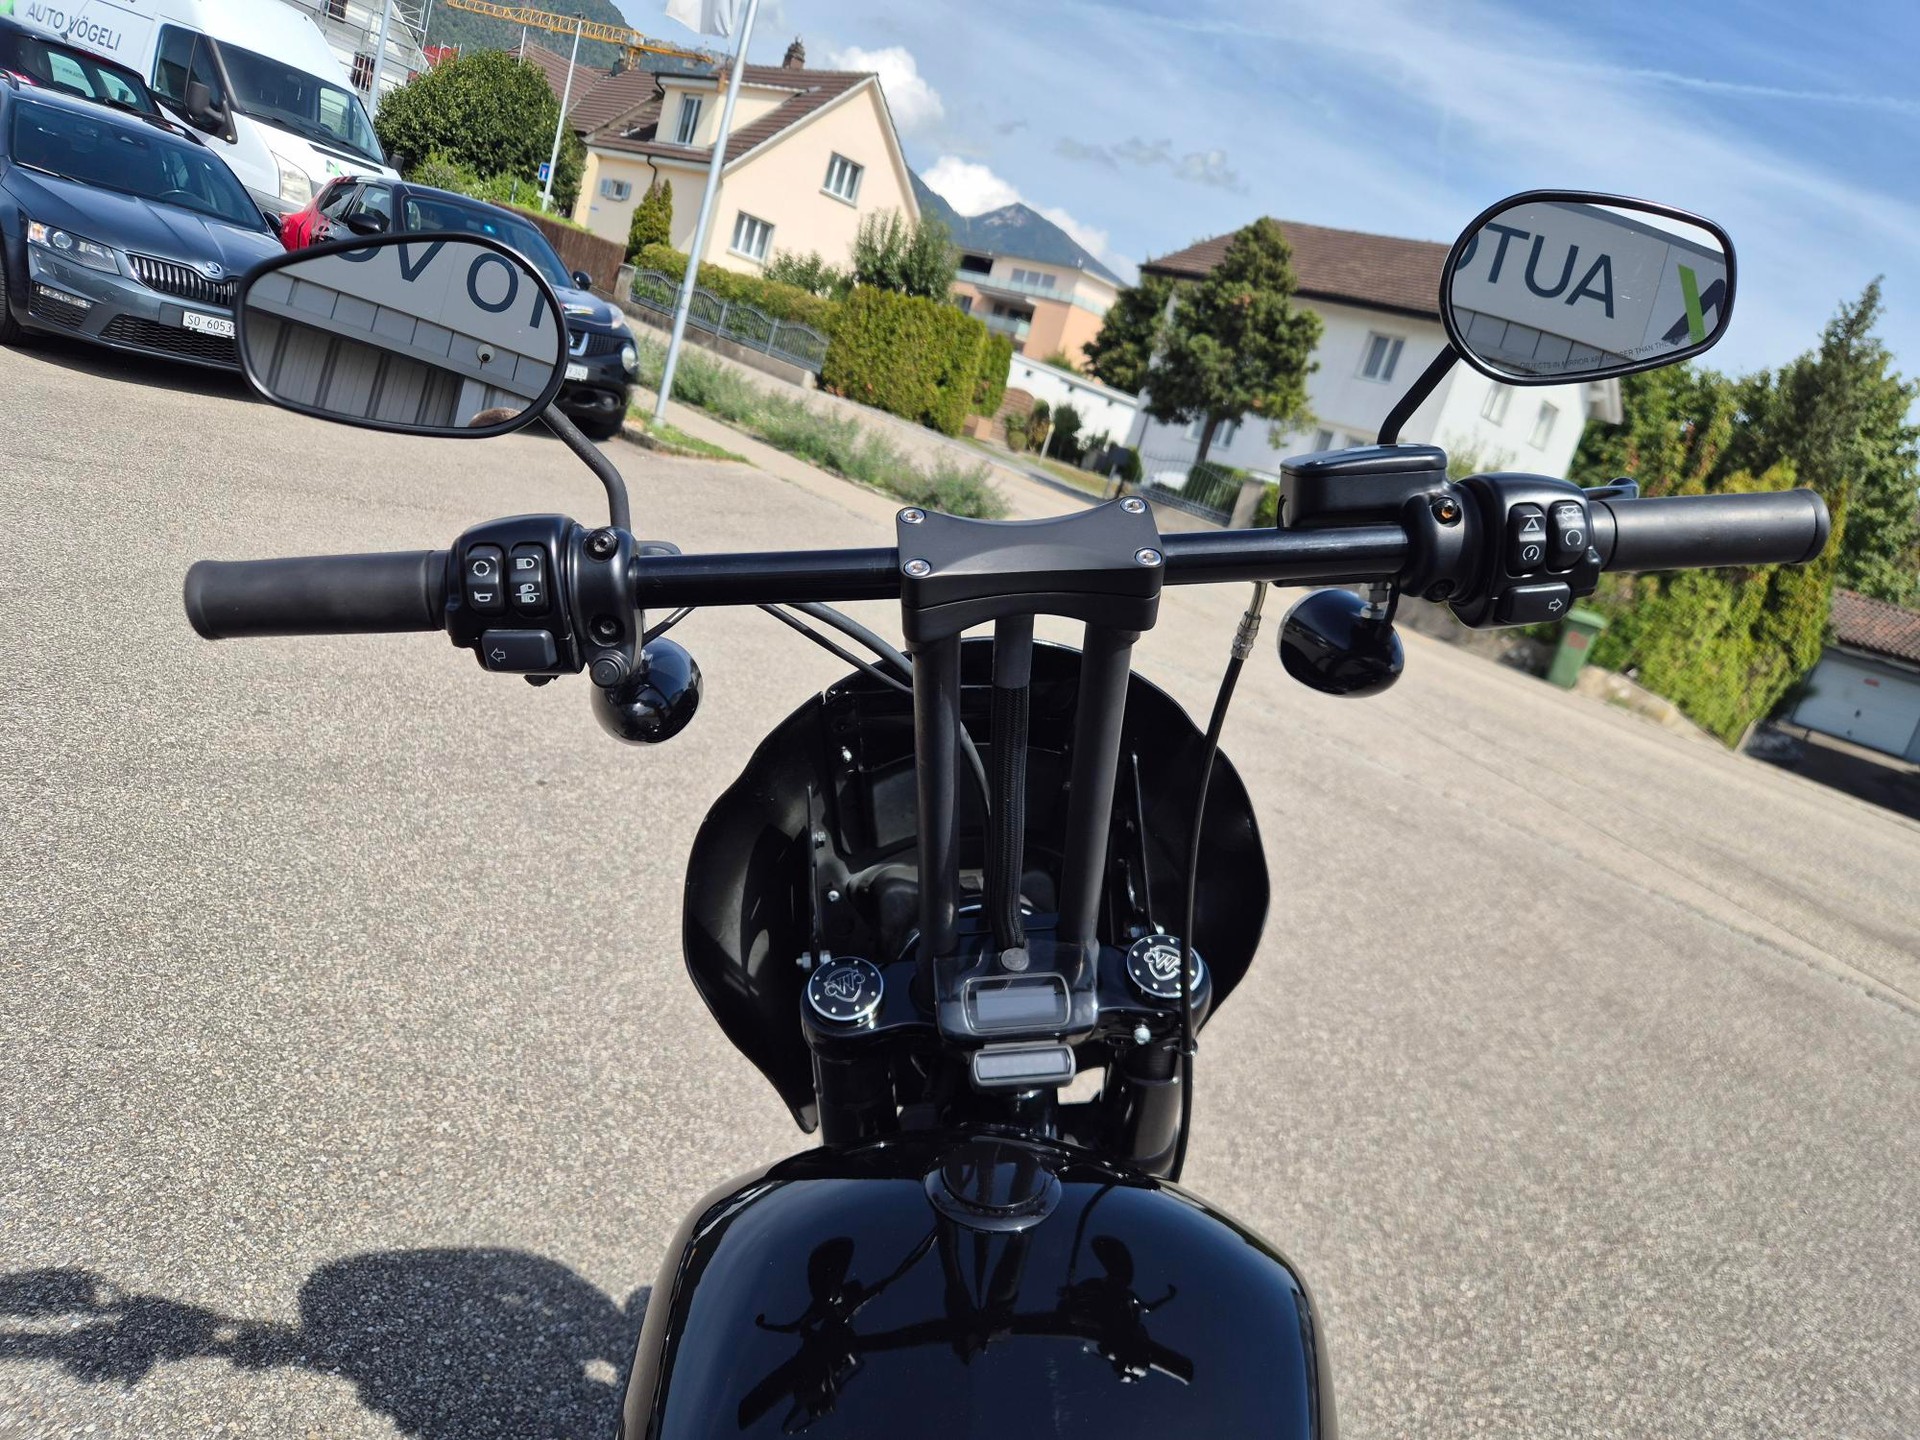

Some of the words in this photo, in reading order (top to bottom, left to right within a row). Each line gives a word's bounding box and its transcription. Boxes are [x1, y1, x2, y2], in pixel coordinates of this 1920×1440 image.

[26, 2, 64, 29] AUTO
[69, 15, 122, 51] VÖGELI
[1635, 345, 1653, 355] THAN
